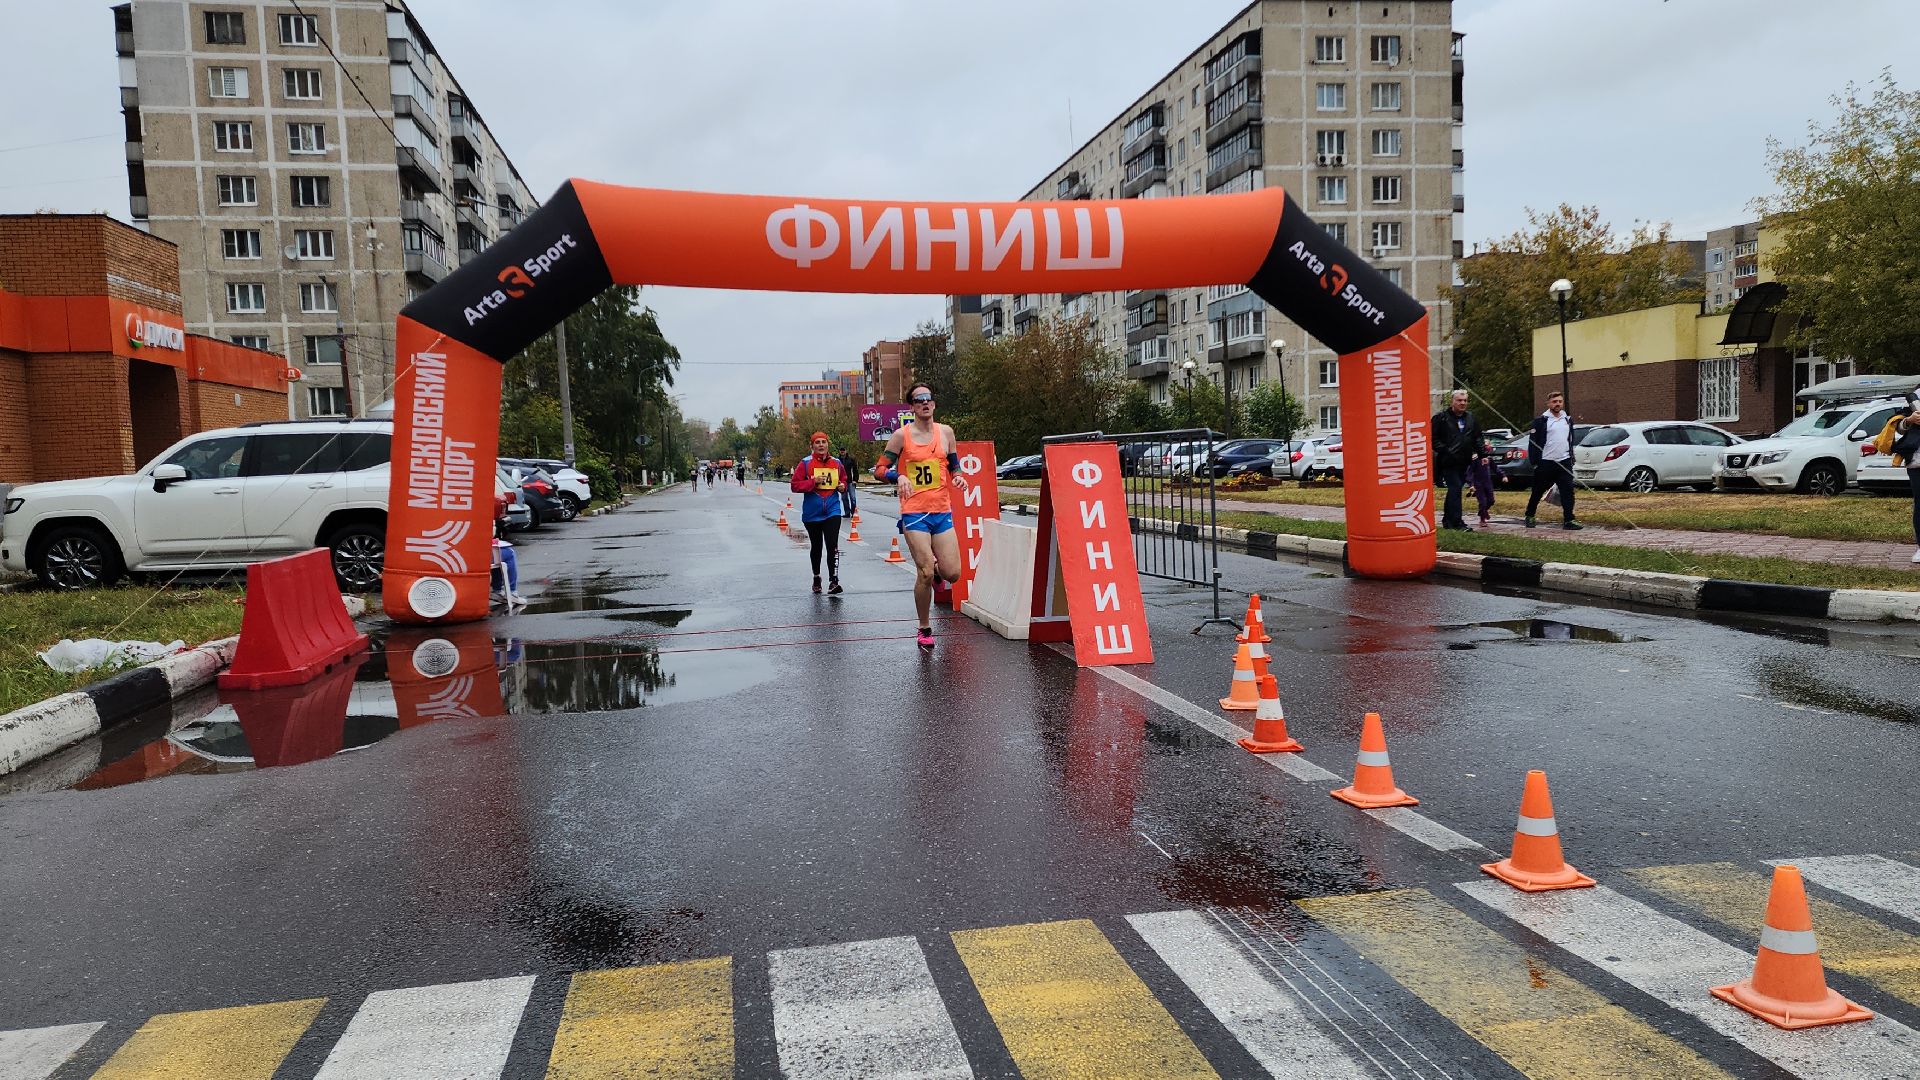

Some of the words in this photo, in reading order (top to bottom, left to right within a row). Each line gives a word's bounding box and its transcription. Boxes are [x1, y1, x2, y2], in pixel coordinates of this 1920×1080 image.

[463, 289, 507, 326] Arta
[523, 233, 577, 277] Sport
[765, 204, 1124, 272] ФИНИШ
[1288, 240, 1325, 276] Arta
[1341, 283, 1386, 325] Sport
[407, 352, 447, 509] МОСКОВСКИЙ
[1367, 349, 1406, 485] МОСКОВСКИЙ
[1406, 420, 1428, 482] СПОРТ
[441, 436, 476, 511] СПОРТ
[915, 465, 932, 486] 26
[959, 453, 984, 598] ФИНИ
[1071, 460, 1133, 655] ФИНИШ
